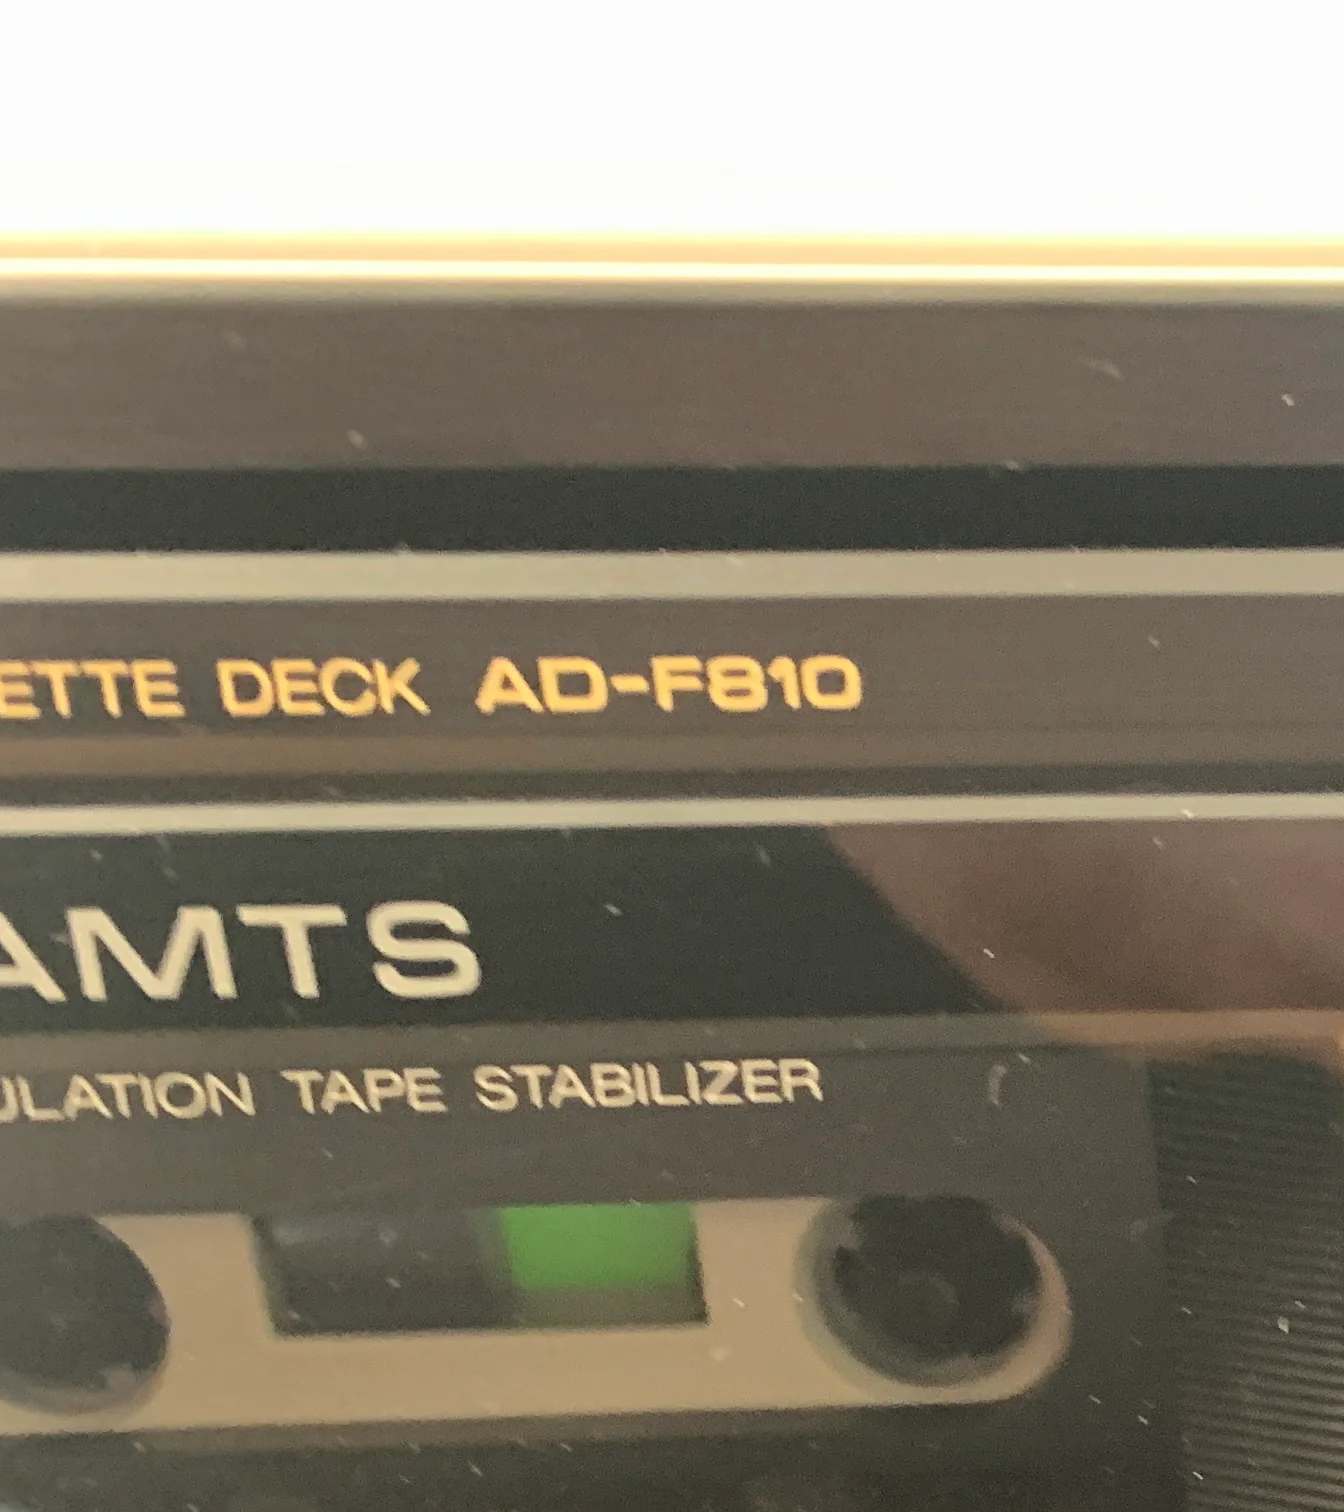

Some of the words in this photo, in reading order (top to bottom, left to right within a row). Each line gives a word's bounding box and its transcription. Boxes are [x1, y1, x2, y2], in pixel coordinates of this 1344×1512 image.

[216, 657, 431, 717] DECK
[475, 654, 863, 714] AD-F810
[280, 1067, 447, 1114] TAPE
[474, 1058, 824, 1111] STABILIZER
